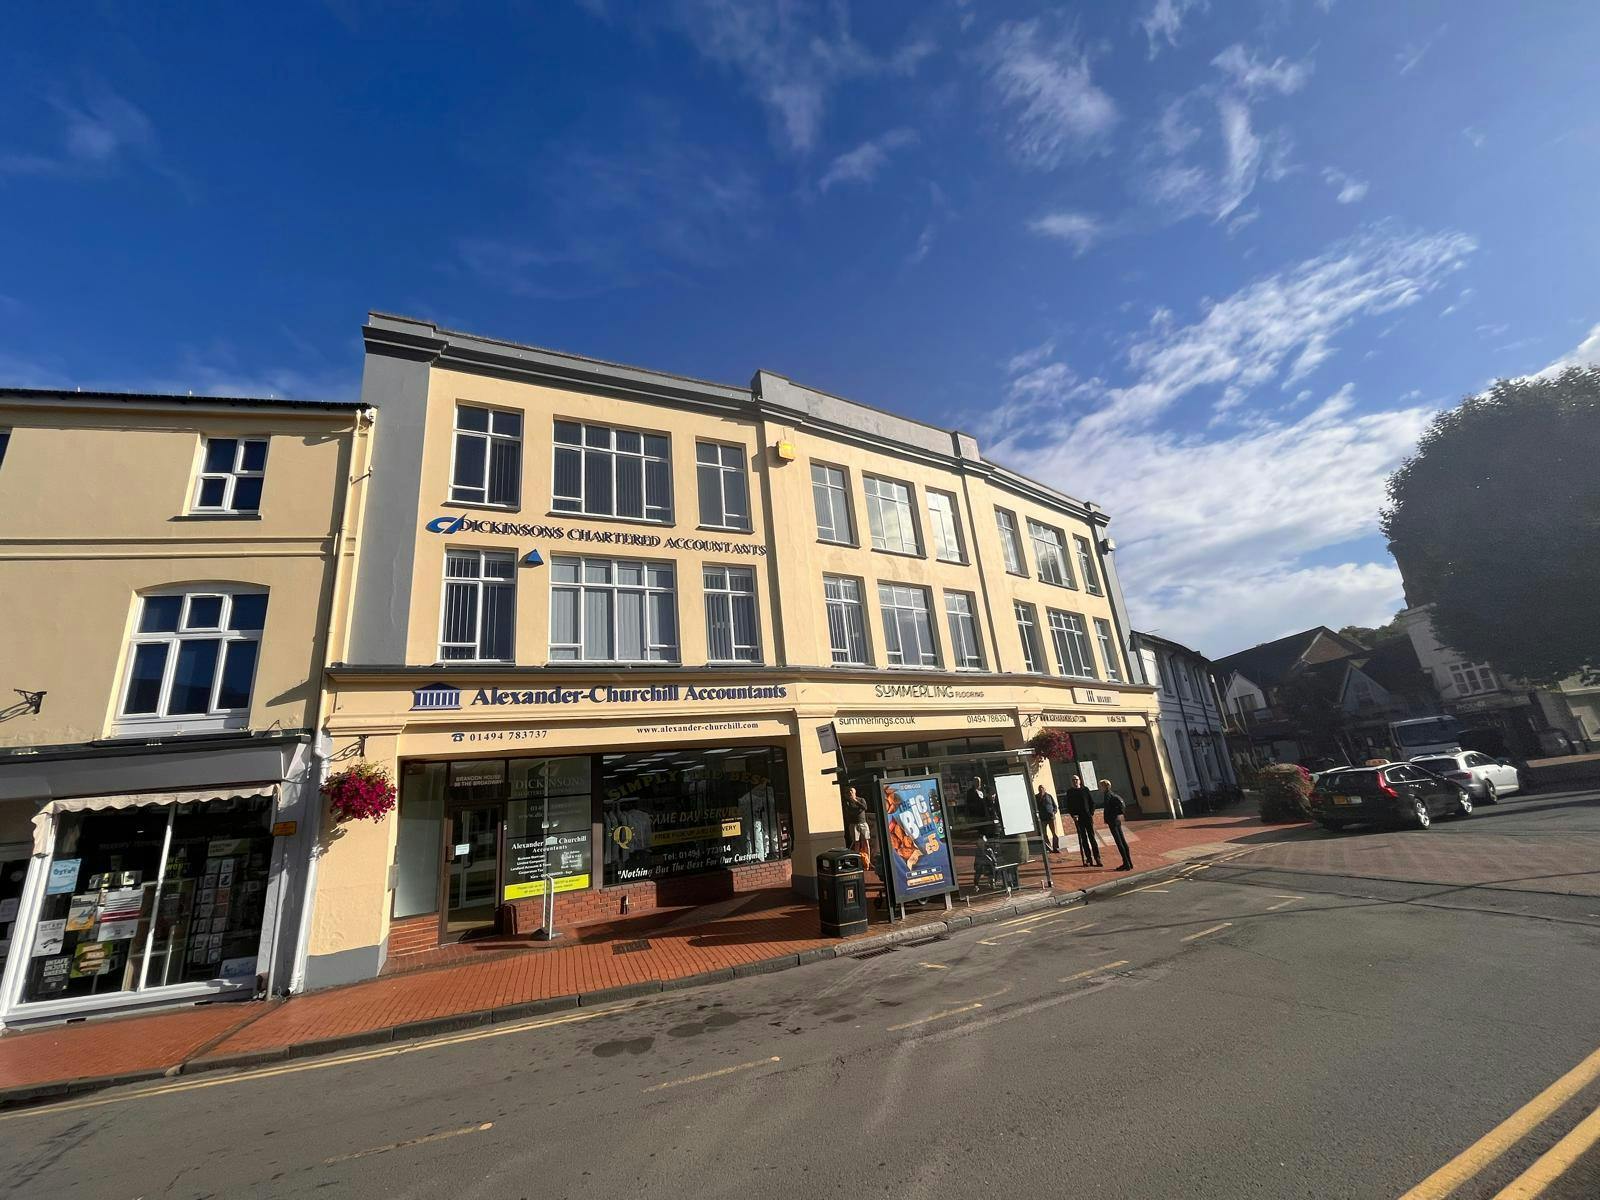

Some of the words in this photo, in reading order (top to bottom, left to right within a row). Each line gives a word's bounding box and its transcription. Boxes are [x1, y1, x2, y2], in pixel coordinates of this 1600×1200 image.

[457, 518, 565, 539] DICKINSONS
[566, 528, 661, 547] CHARTERED
[663, 537, 767, 556] ACCOUNTANTS
[470, 684, 679, 706] Alexander-Churchill
[684, 684, 787, 701] Accountants
[874, 684, 954, 698] SUMMERLING
[839, 716, 916, 728] summerlings.co.uk
[966, 715, 987, 724] 01494
[636, 721, 759, 734] www.alexander-churchill.com
[469, 732, 504, 742] 01494
[508, 730, 548, 741] 783737
[515, 776, 585, 789] DICKNSONS
[607, 769, 681, 800] SIMPLY
[511, 841, 544, 850] Alexander
[558, 835, 587, 845] Churchill
[532, 845, 568, 853] Accountants
